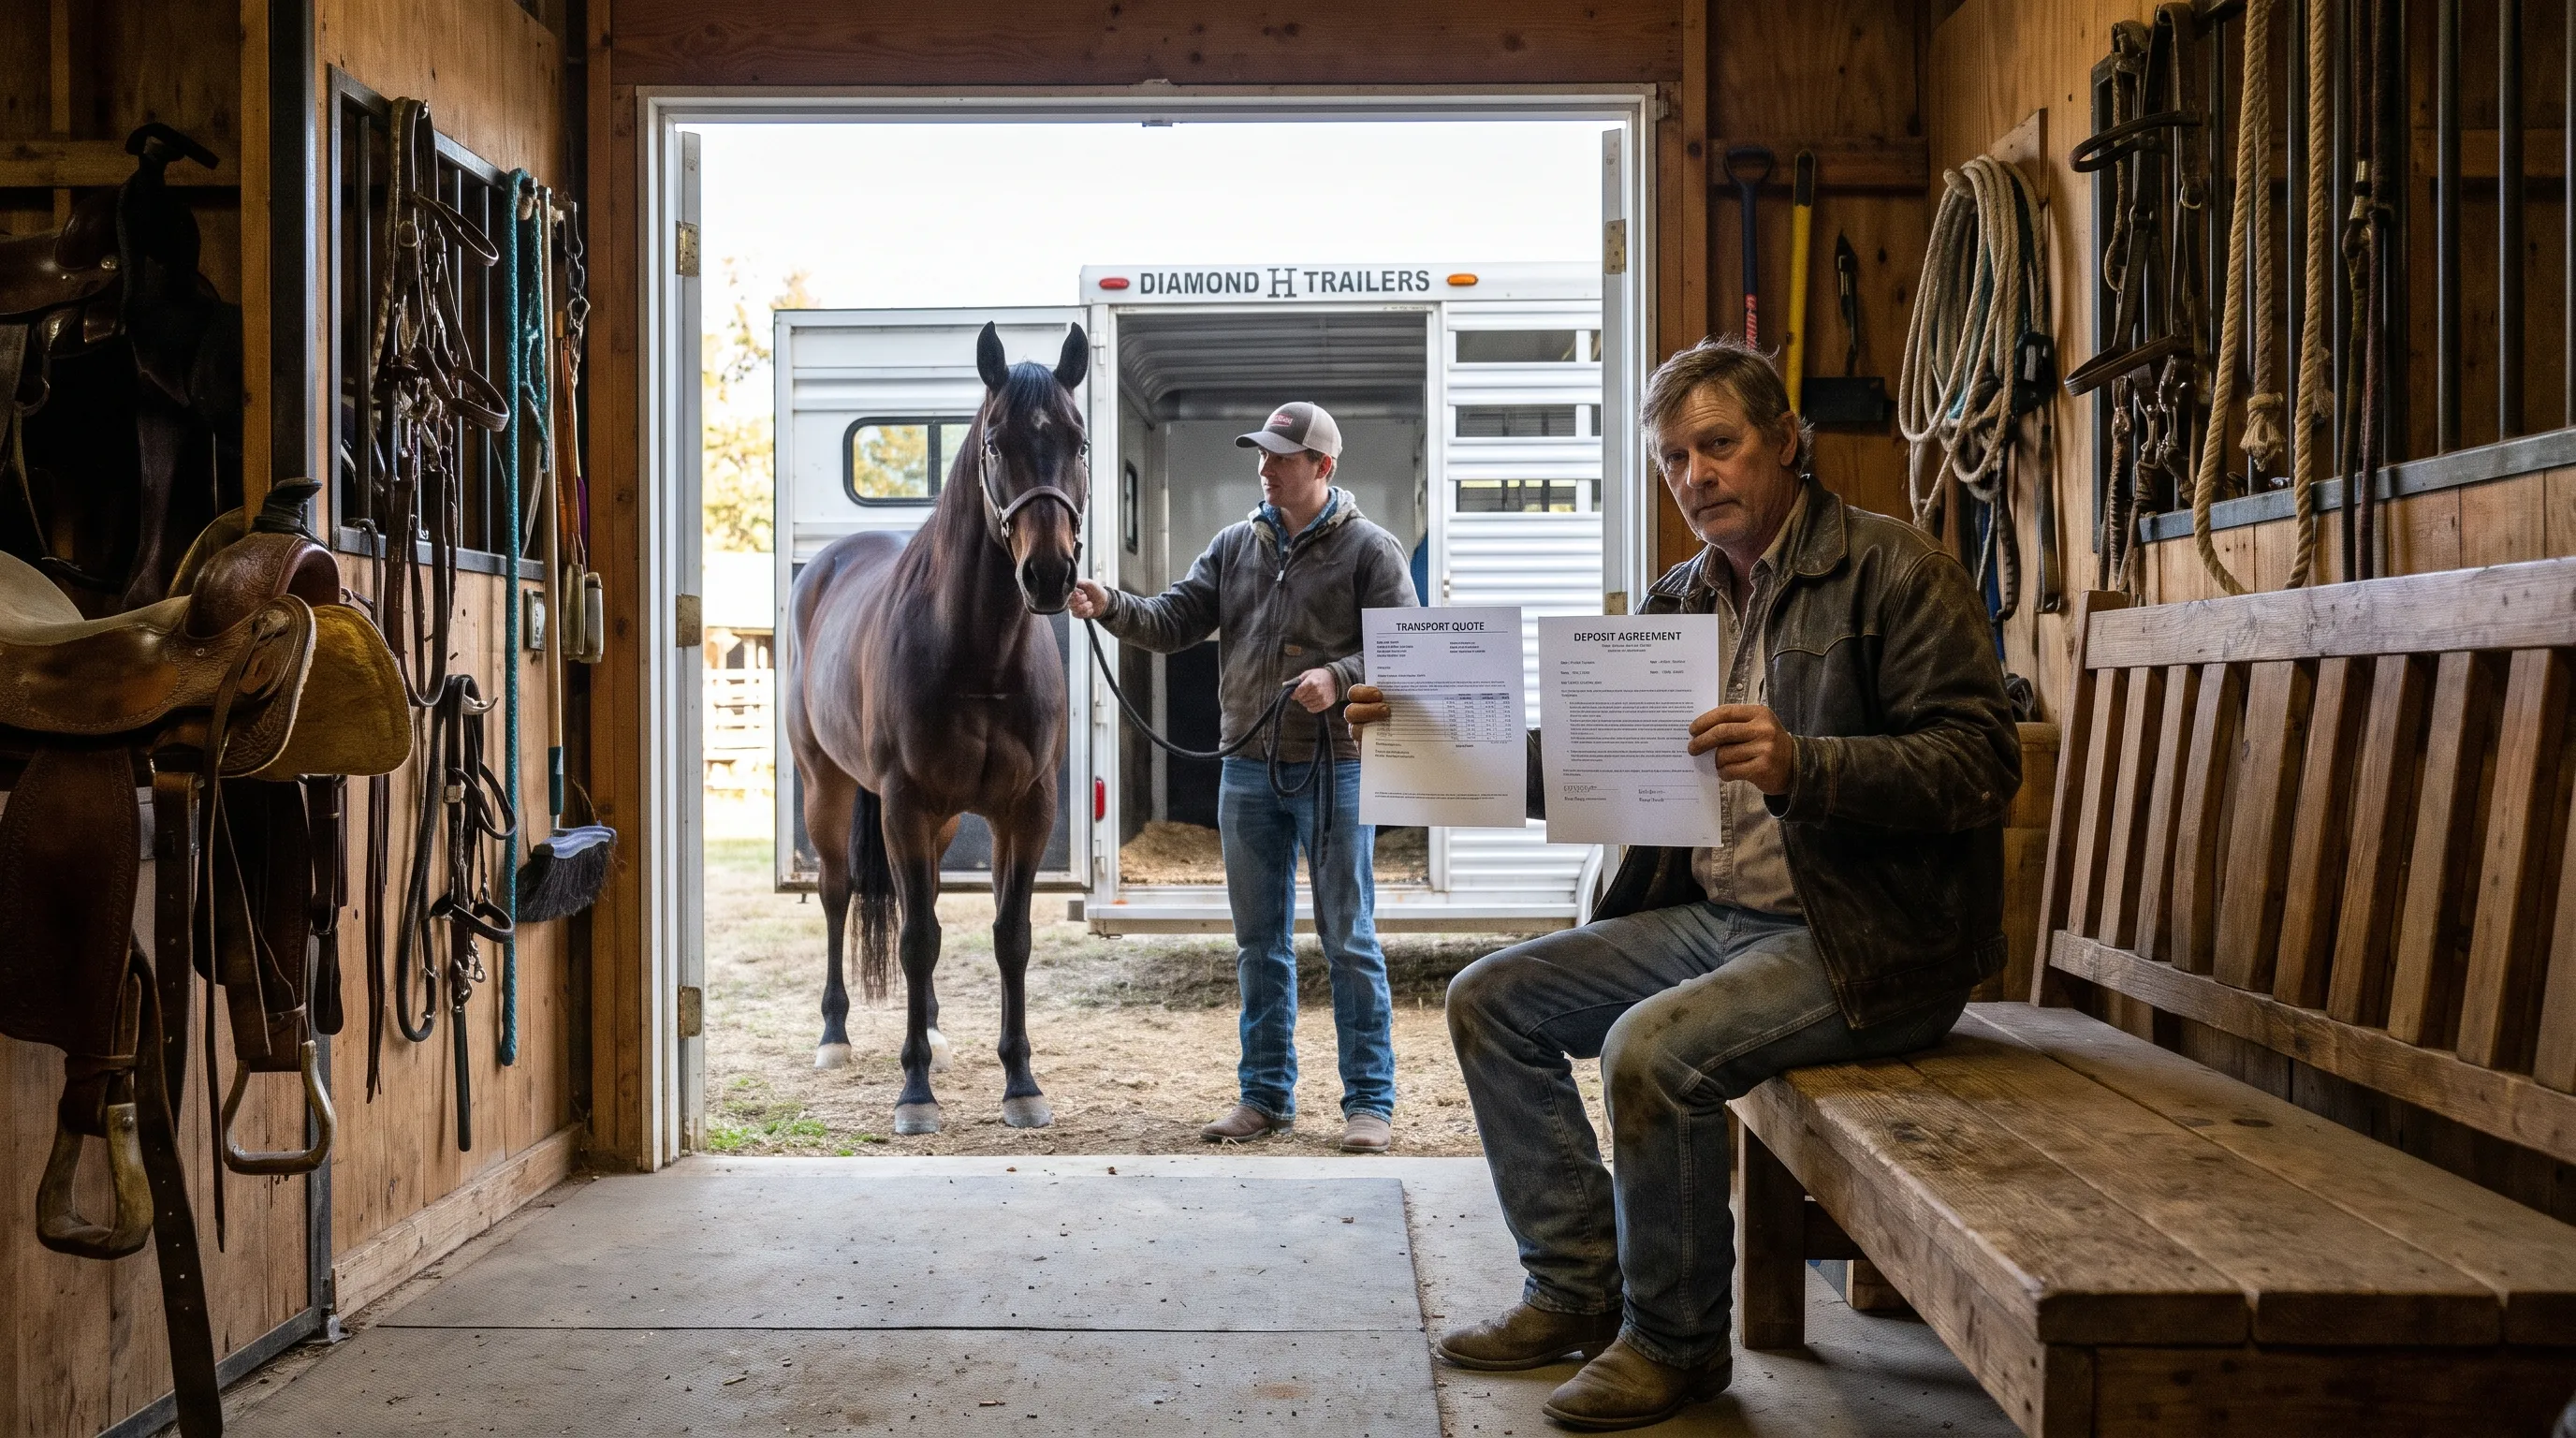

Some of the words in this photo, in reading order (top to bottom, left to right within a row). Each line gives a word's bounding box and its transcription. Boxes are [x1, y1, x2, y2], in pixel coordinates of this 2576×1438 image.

[1140, 272, 1259, 294] DIAMOND
[1266, 268, 1297, 298] H
[1304, 270, 1430, 292] TRAILERS
[1396, 622, 1450, 631] TRANSPORT
[1452, 622, 1485, 631] QUOTE
[1573, 632, 1616, 641] DEPOSIT
[1618, 631, 1681, 641] AGREEMENT
